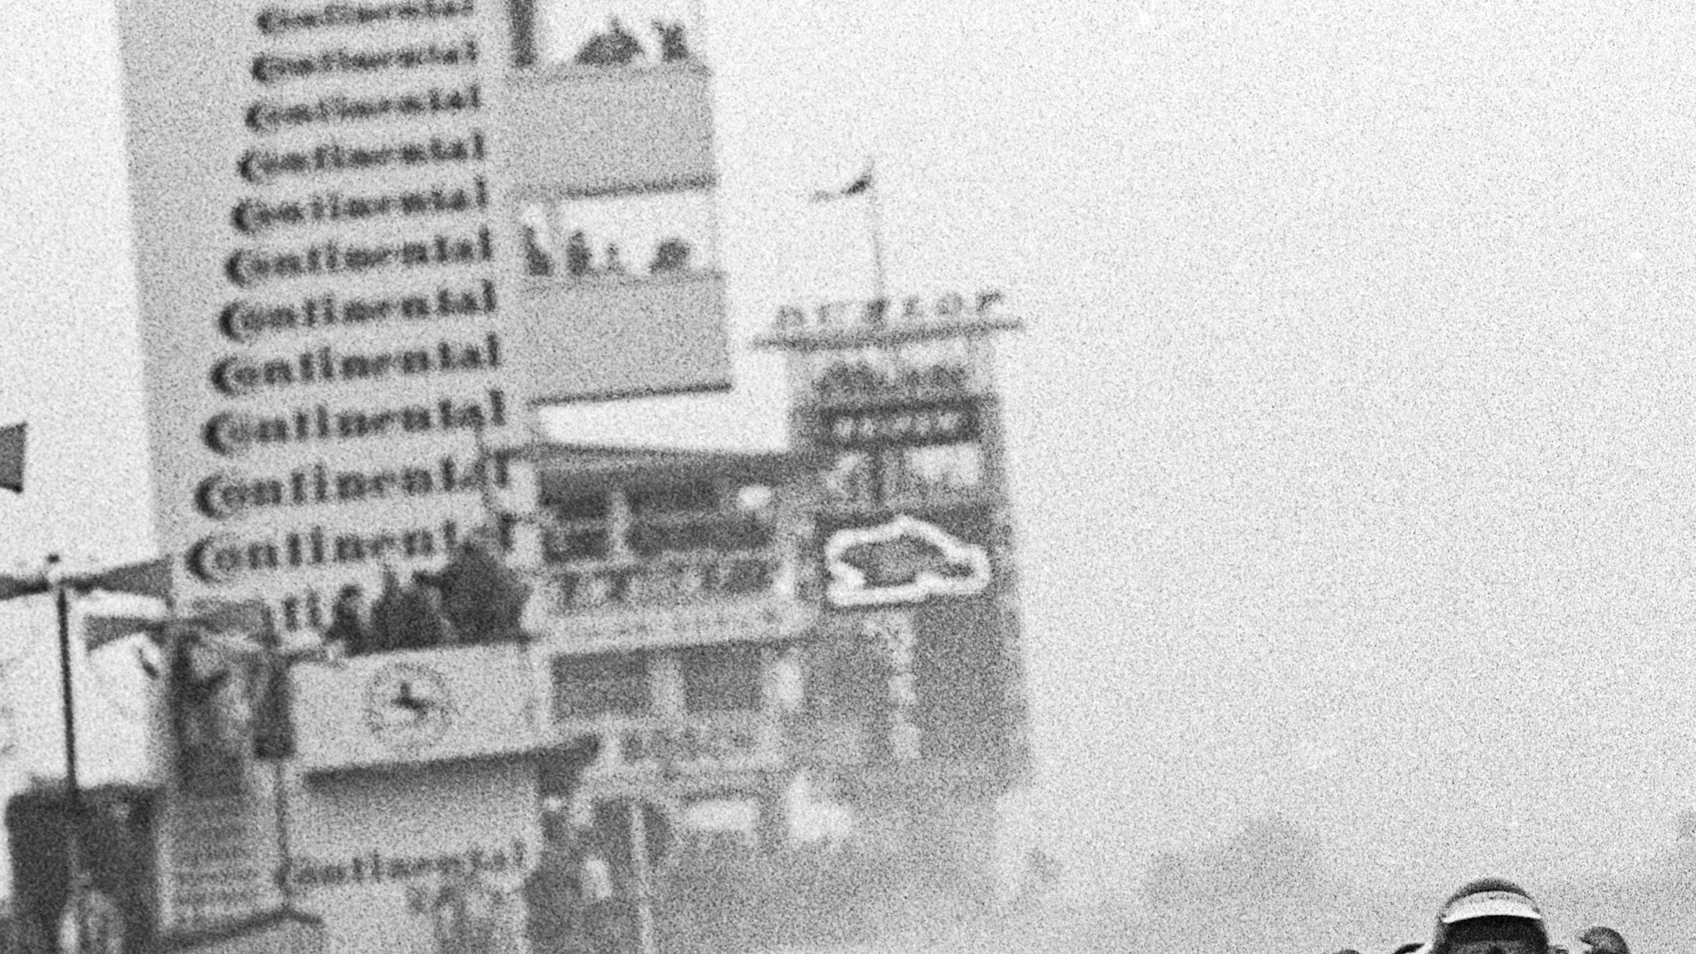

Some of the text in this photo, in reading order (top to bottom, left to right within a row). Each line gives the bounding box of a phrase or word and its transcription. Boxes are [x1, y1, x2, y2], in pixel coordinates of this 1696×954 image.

[252, 41, 476, 82] Continental
[246, 84, 479, 130] Continental
[238, 129, 485, 180] Continental
[231, 176, 488, 232] Continental
[224, 225, 492, 286] Continental
[216, 279, 495, 342] Continental
[208, 333, 499, 397] Continental
[202, 389, 504, 453] Continental
